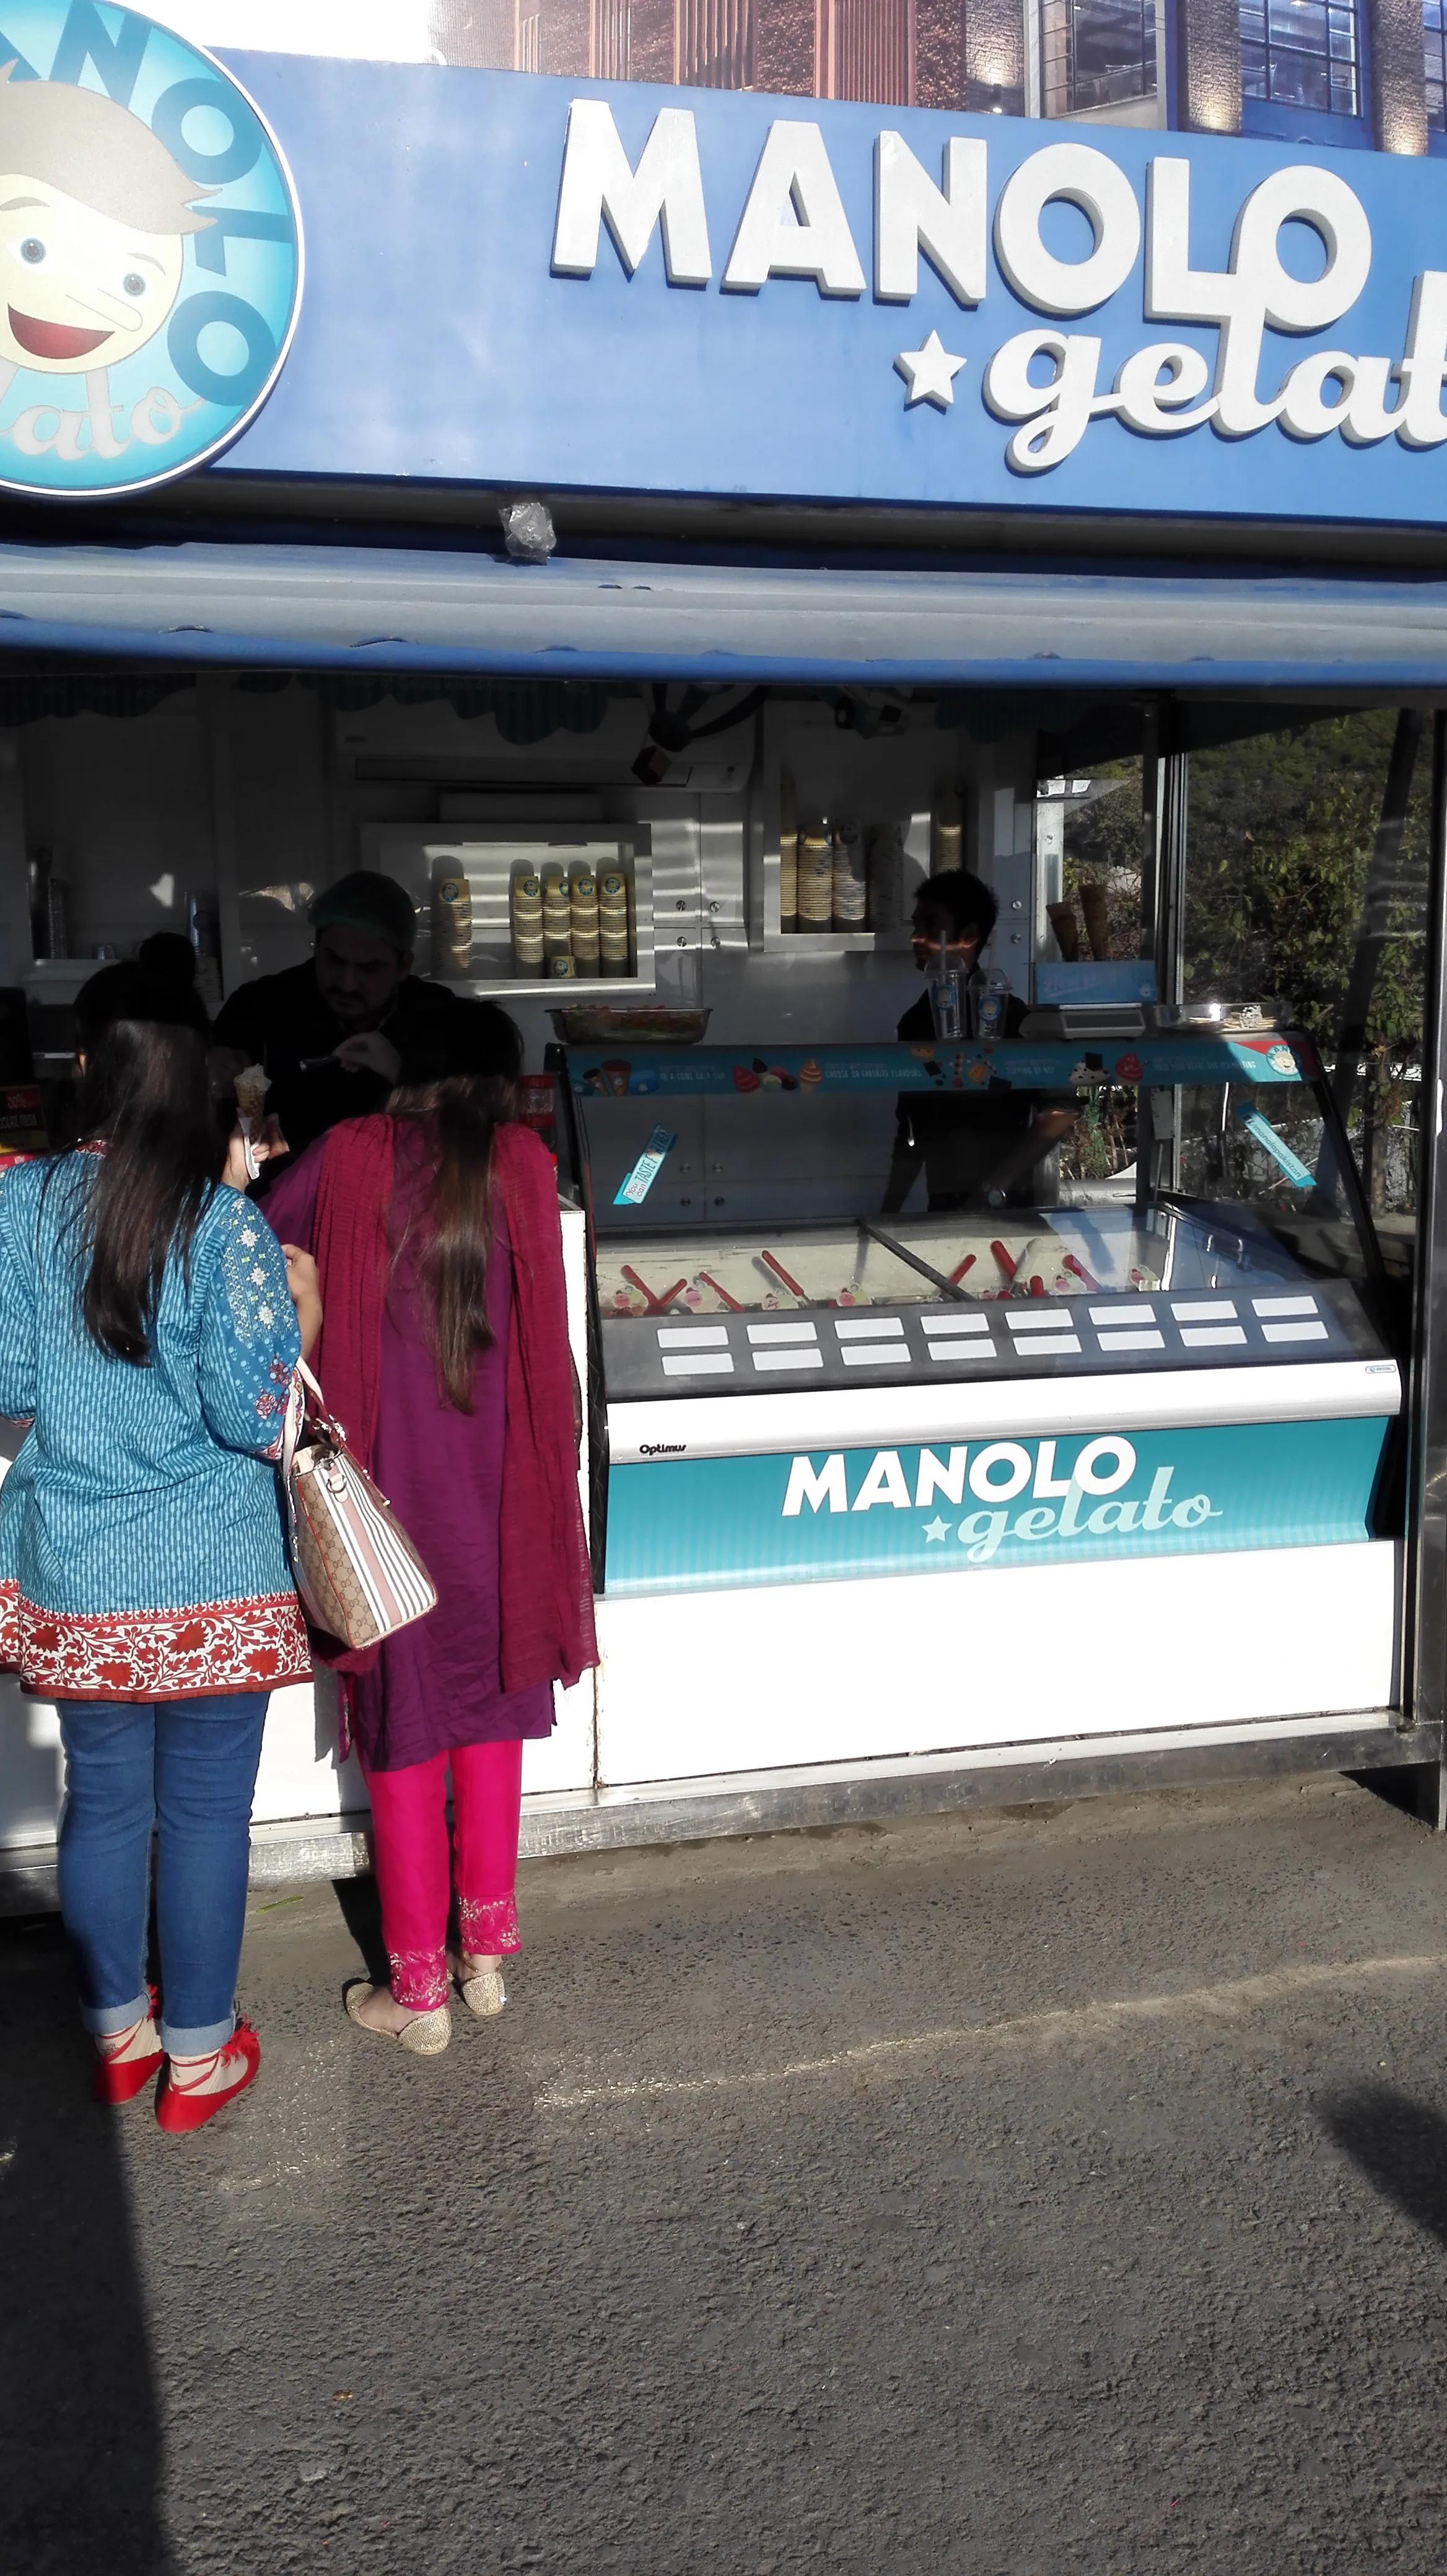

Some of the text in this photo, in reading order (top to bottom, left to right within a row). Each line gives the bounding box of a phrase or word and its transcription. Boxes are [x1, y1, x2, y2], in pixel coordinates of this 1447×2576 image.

[550, 97, 1371, 332] MANOLO
[634, 1159, 655, 1184] TASTE
[639, 1443, 687, 1456] Optimus
[780, 1435, 1137, 1517] MANOLO
[956, 1466, 1224, 1563] gelato
